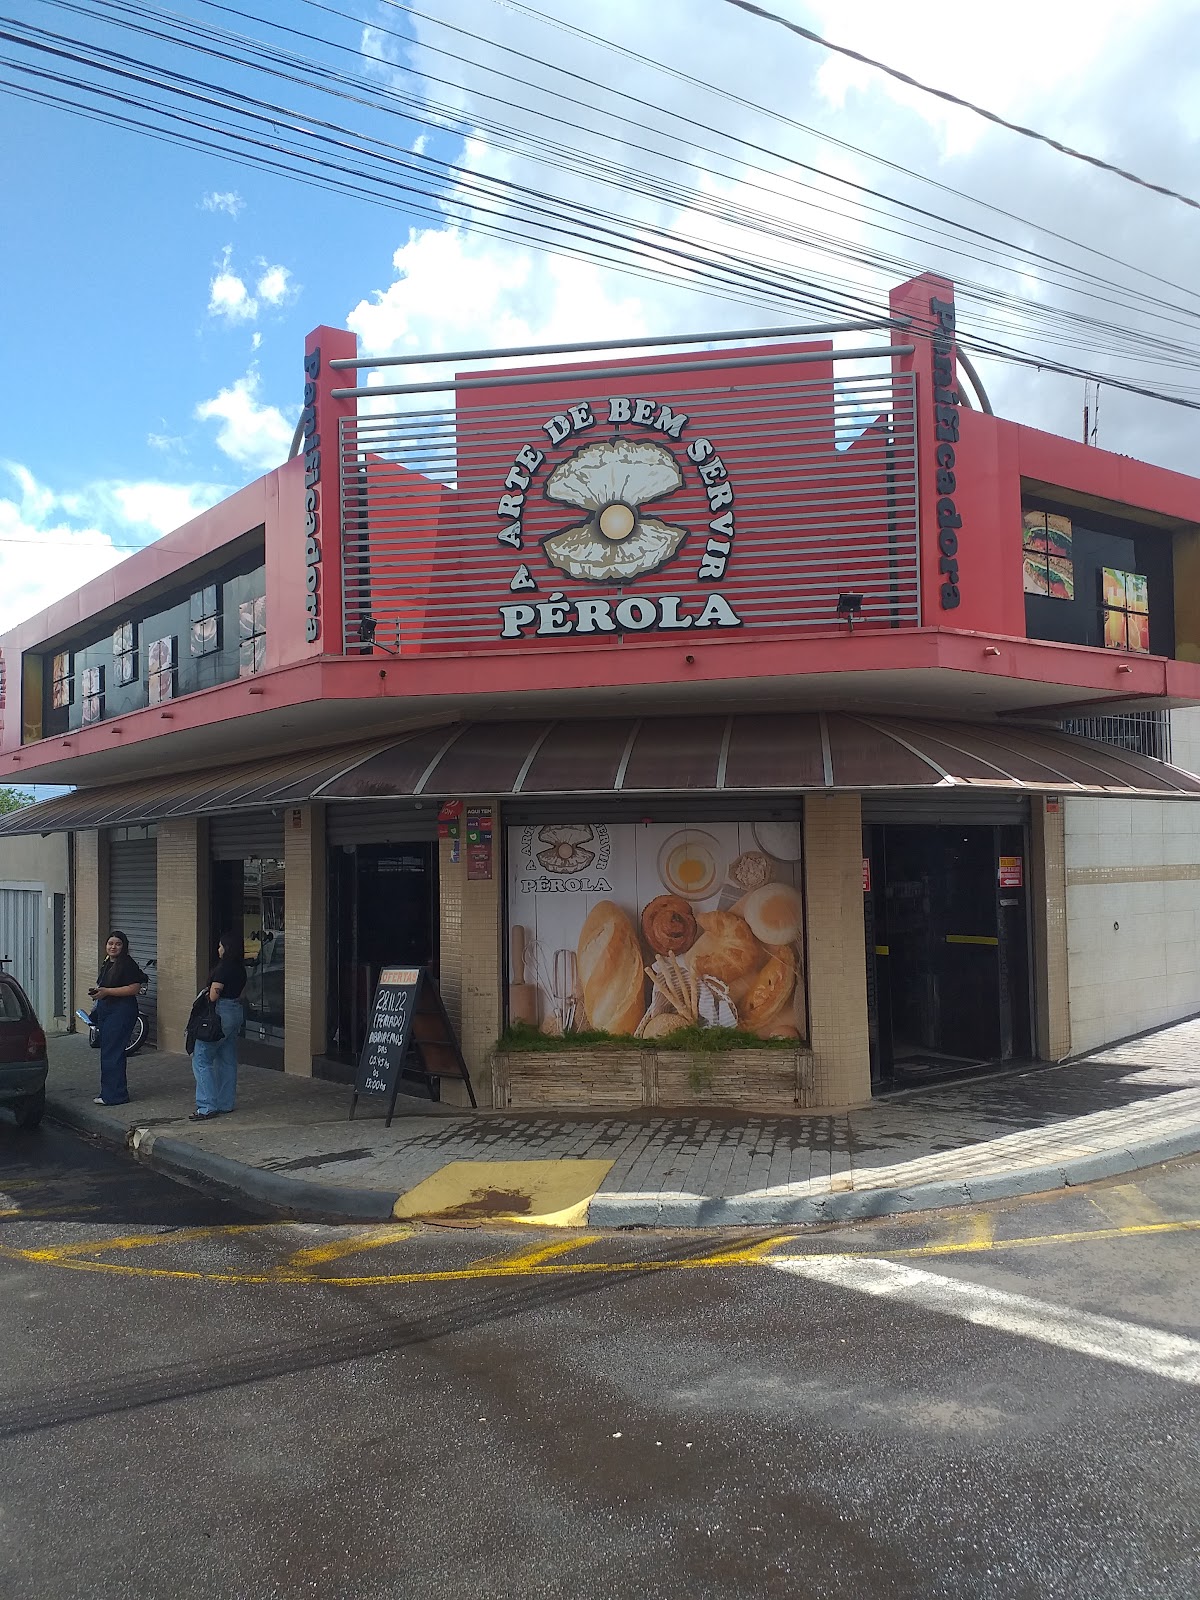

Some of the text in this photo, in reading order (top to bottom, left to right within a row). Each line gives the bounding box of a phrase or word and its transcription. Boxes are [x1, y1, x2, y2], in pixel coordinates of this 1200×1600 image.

[304, 347, 322, 643] Panificadora
[497, 397, 736, 590] A ARTE DE BEM SERVIR
[929, 296, 962, 610] Panificadora
[499, 592, 742, 638] PÉROLA
[521, 876, 613, 894] PÉROLA
[381, 971, 417, 983] OFERTAS
